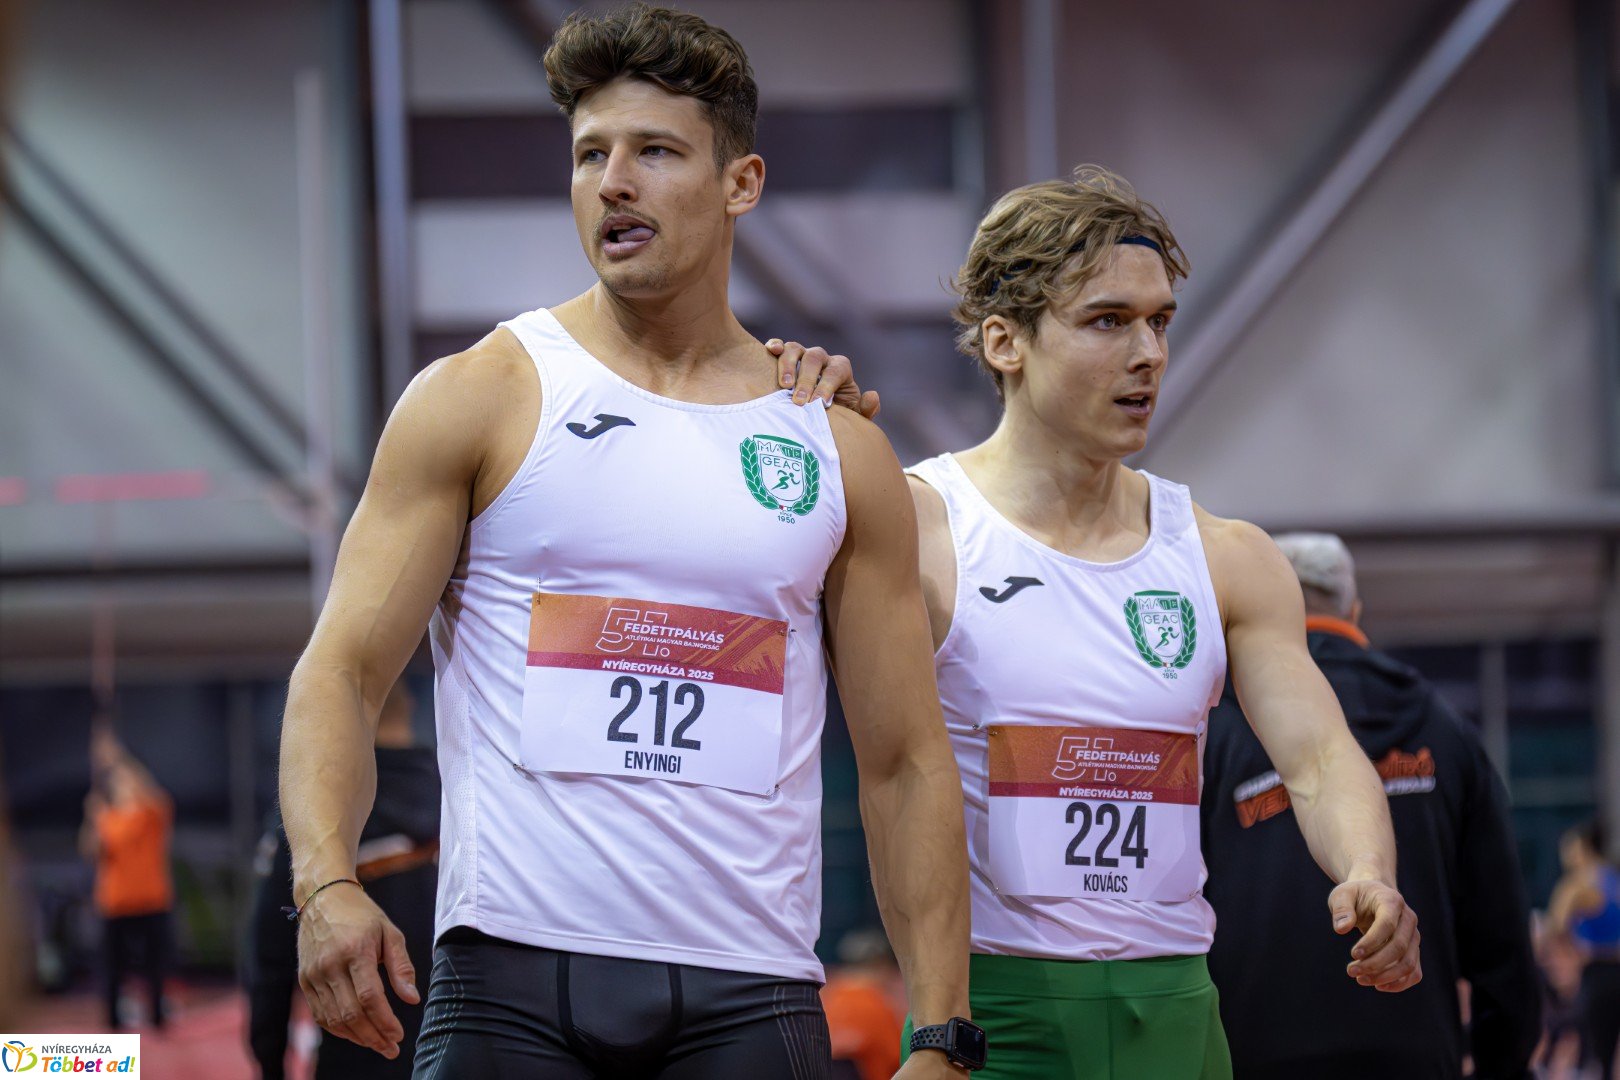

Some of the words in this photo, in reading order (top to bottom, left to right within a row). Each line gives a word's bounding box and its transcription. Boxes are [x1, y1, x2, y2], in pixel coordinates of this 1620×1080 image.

[762, 456, 801, 472] GEAC
[777, 515, 796, 525] 1950
[1143, 614, 1179, 625] GEAC
[623, 622, 725, 644] FEDETTPÁLYÁS
[624, 634, 656, 643] ATLÉTIKAI
[656, 638, 684, 646] MAGYAR
[683, 640, 721, 651] BAJNOKSÁG
[602, 659, 686, 677] NYÍREGYHÁZA
[687, 668, 715, 681] 2025
[1162, 672, 1179, 680] 1950
[607, 675, 705, 751] 212
[624, 750, 681, 774] ENYINGI
[1076, 750, 1161, 764] FEDETTPÁLYÁS
[1059, 786, 1129, 799] NYÍREGYHÁZA
[1130, 790, 1154, 801] 2025
[1065, 801, 1149, 869] 224
[1083, 872, 1129, 893] KOVÁCS
